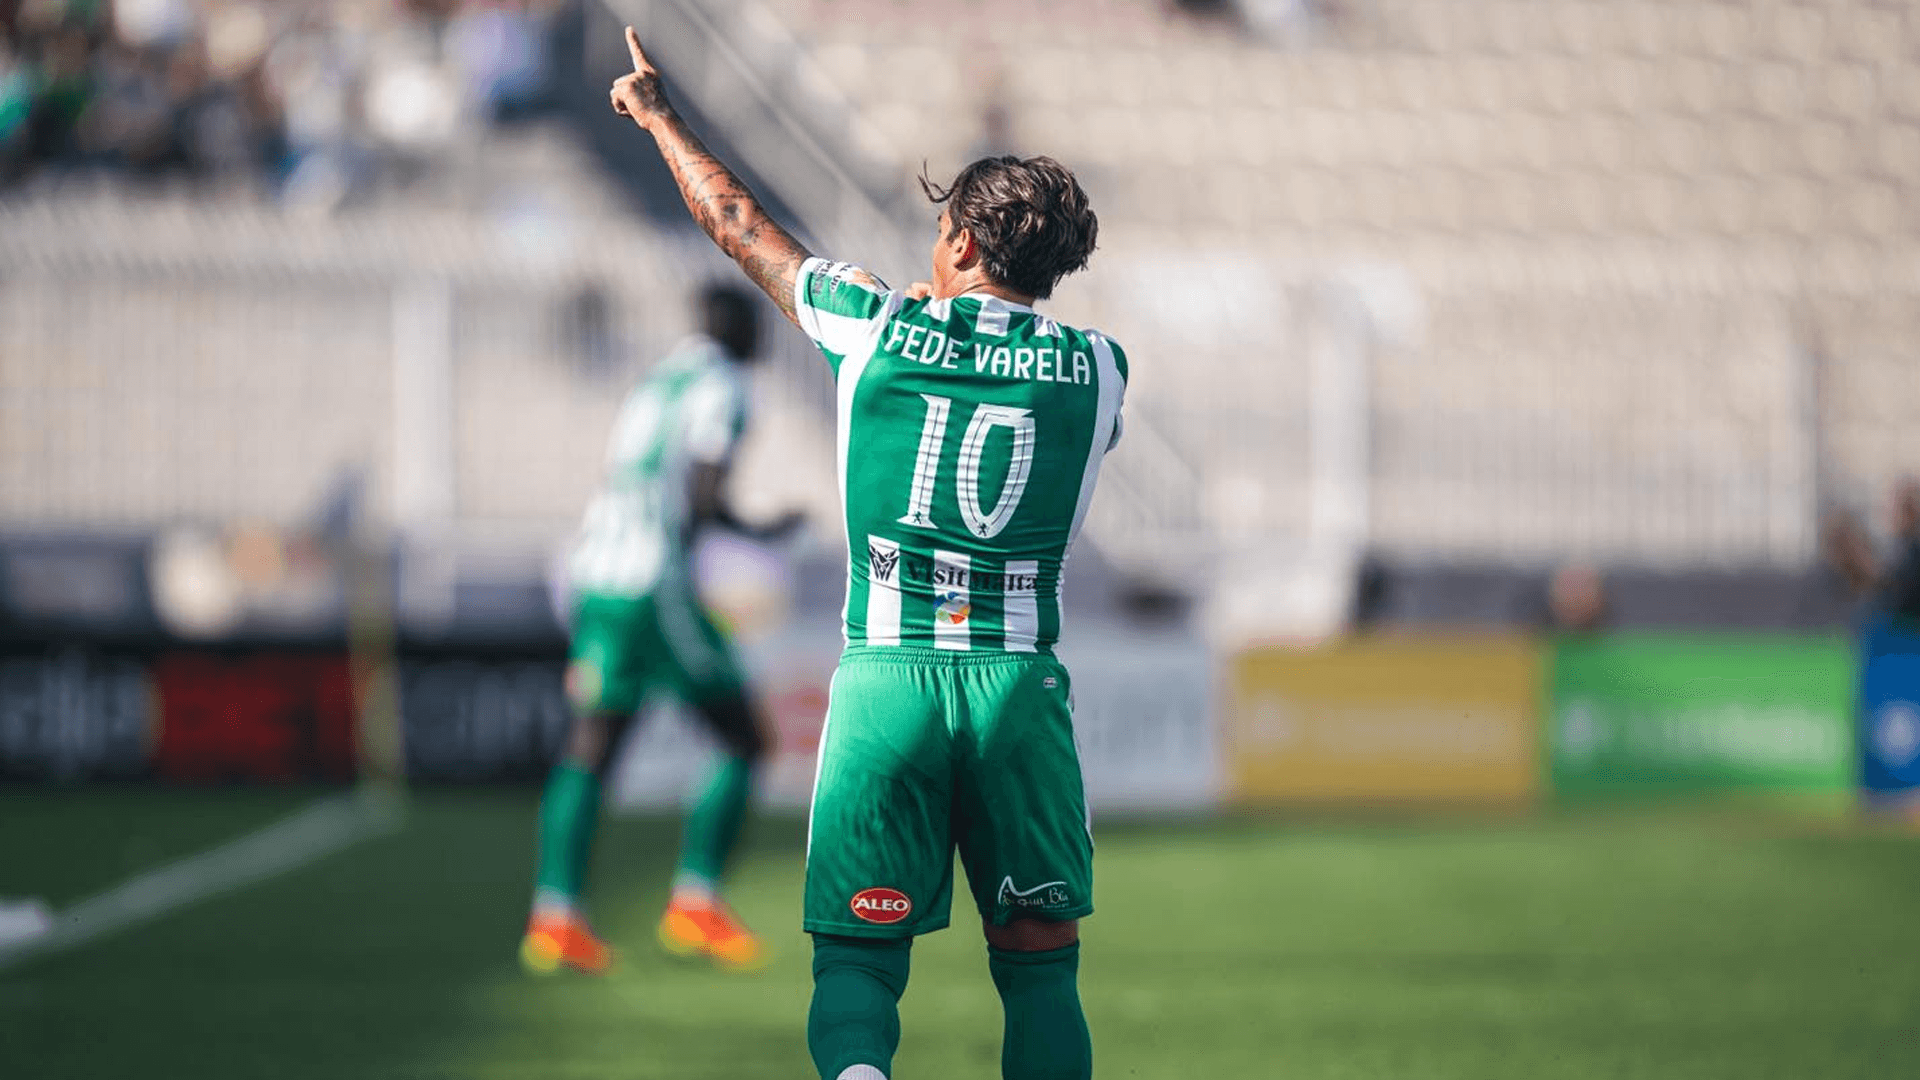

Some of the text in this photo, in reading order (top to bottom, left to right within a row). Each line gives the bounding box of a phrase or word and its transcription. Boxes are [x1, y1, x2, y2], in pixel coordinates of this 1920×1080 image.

[884, 319, 1091, 386] FEDE VARELA
[896, 392, 1036, 539] 10
[906, 560, 968, 588] Visit
[854, 897, 908, 911] ALEO
